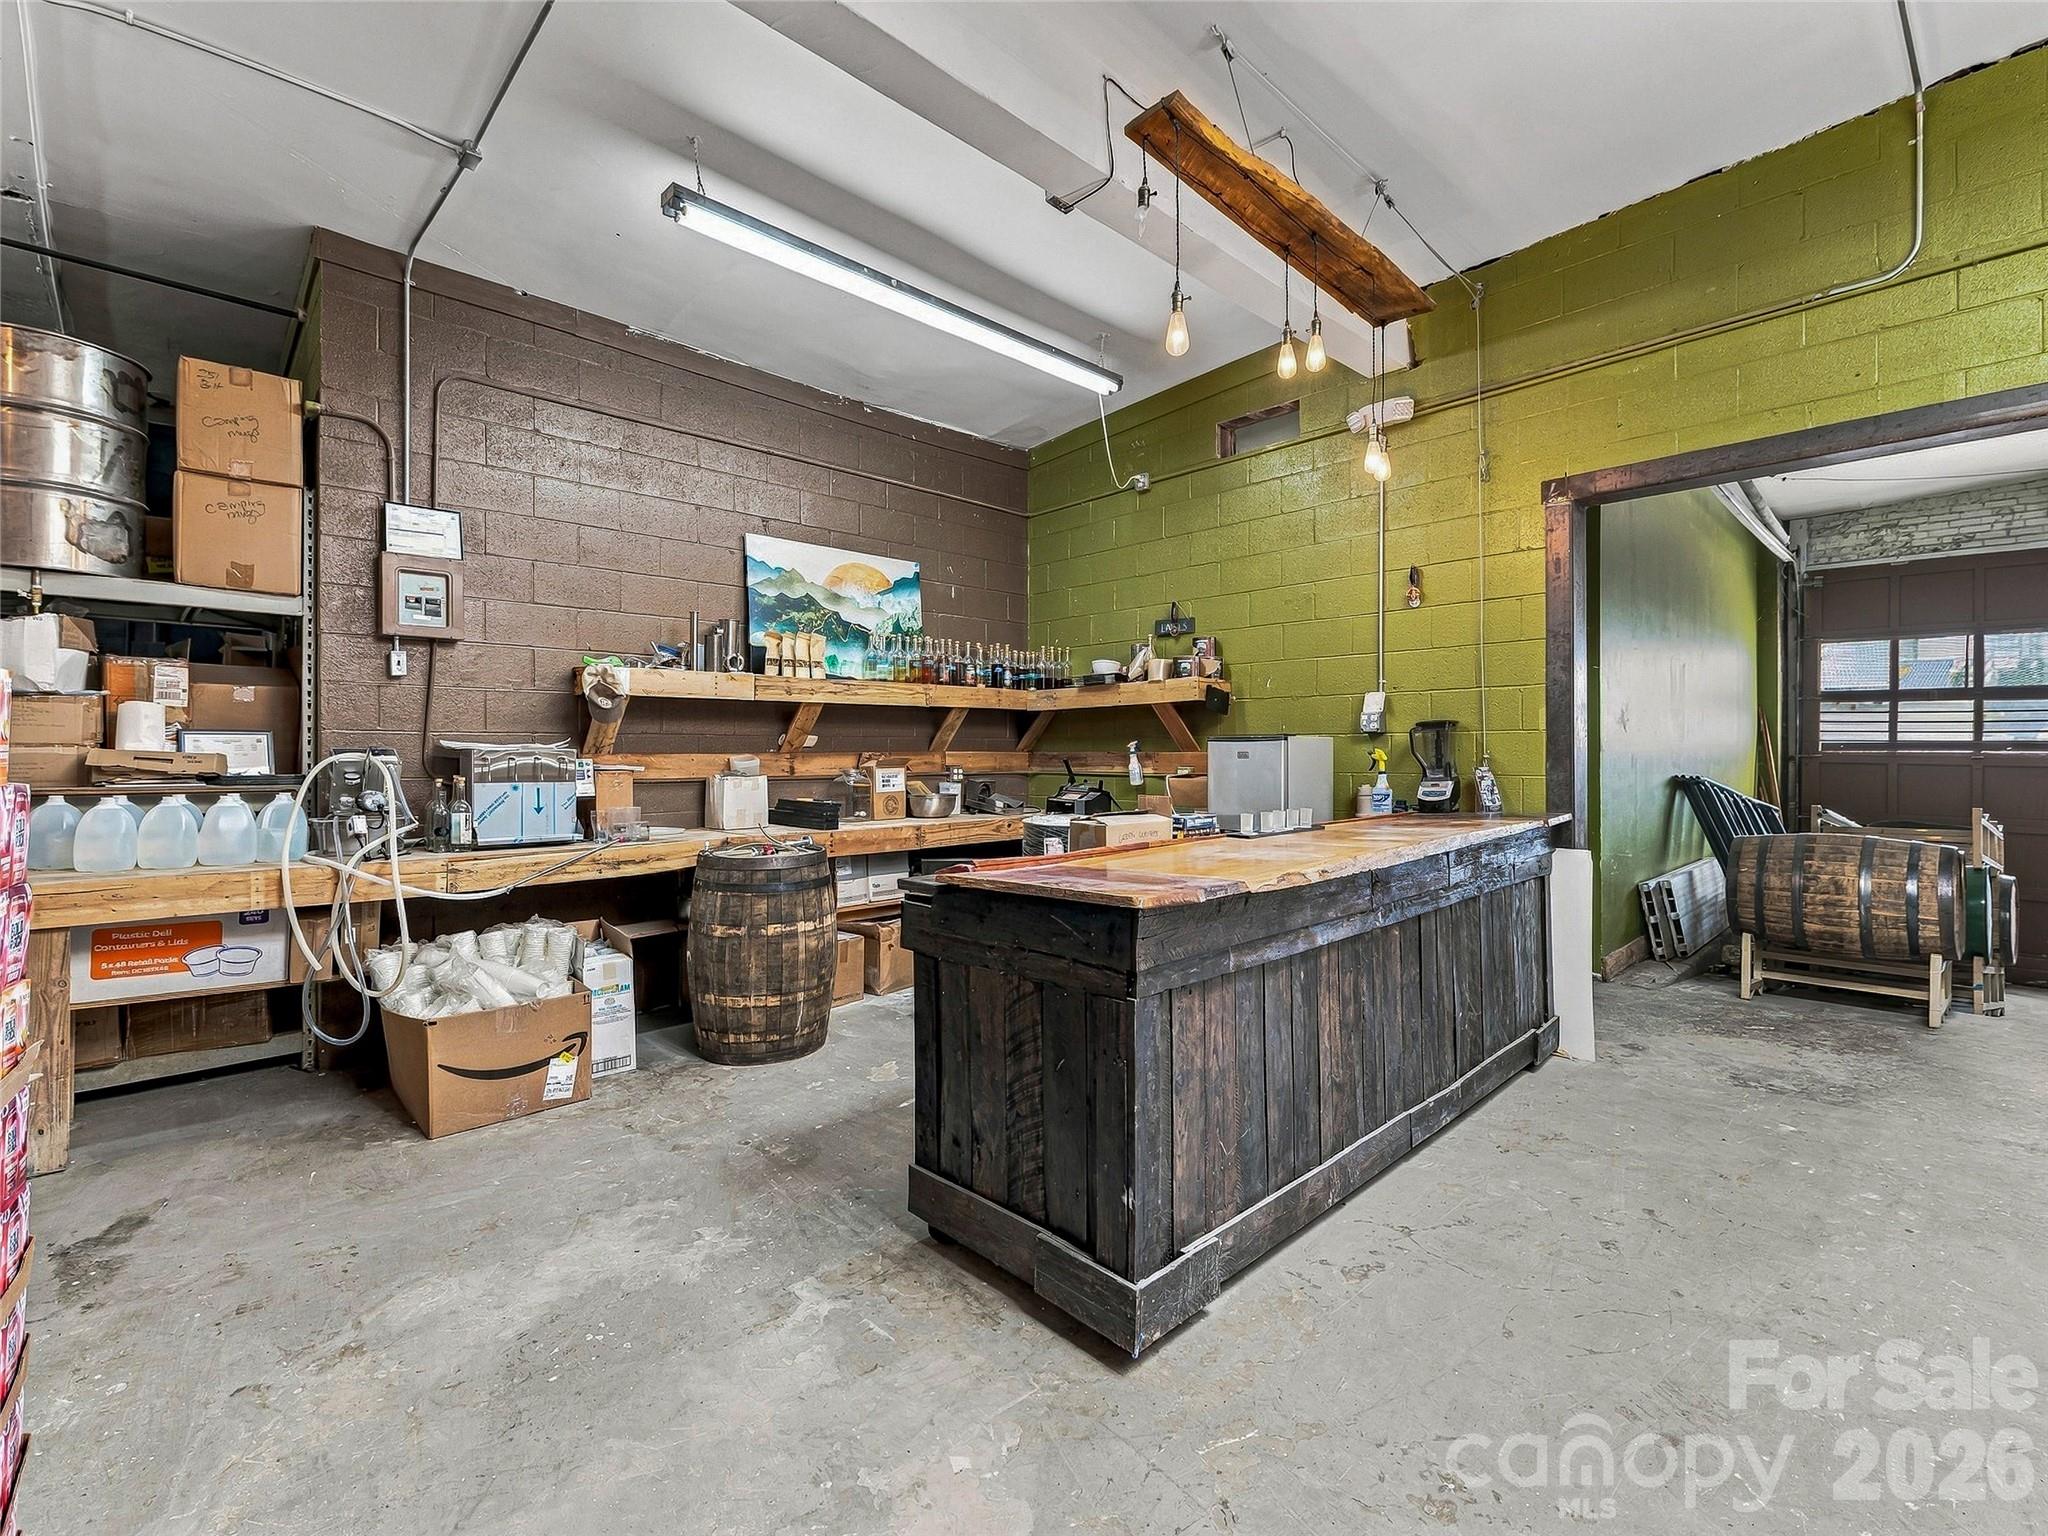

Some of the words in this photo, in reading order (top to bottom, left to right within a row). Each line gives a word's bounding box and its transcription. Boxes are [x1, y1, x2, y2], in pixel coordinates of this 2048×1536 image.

[111, 931, 150, 940] Plastic
[152, 929, 172, 937] Deli
[94, 941, 156, 952] Containers
[157, 939, 166, 947] &
[167, 938, 189, 946] Lids
[127, 959, 153, 967] Retail
[154, 957, 179, 965] Packs
